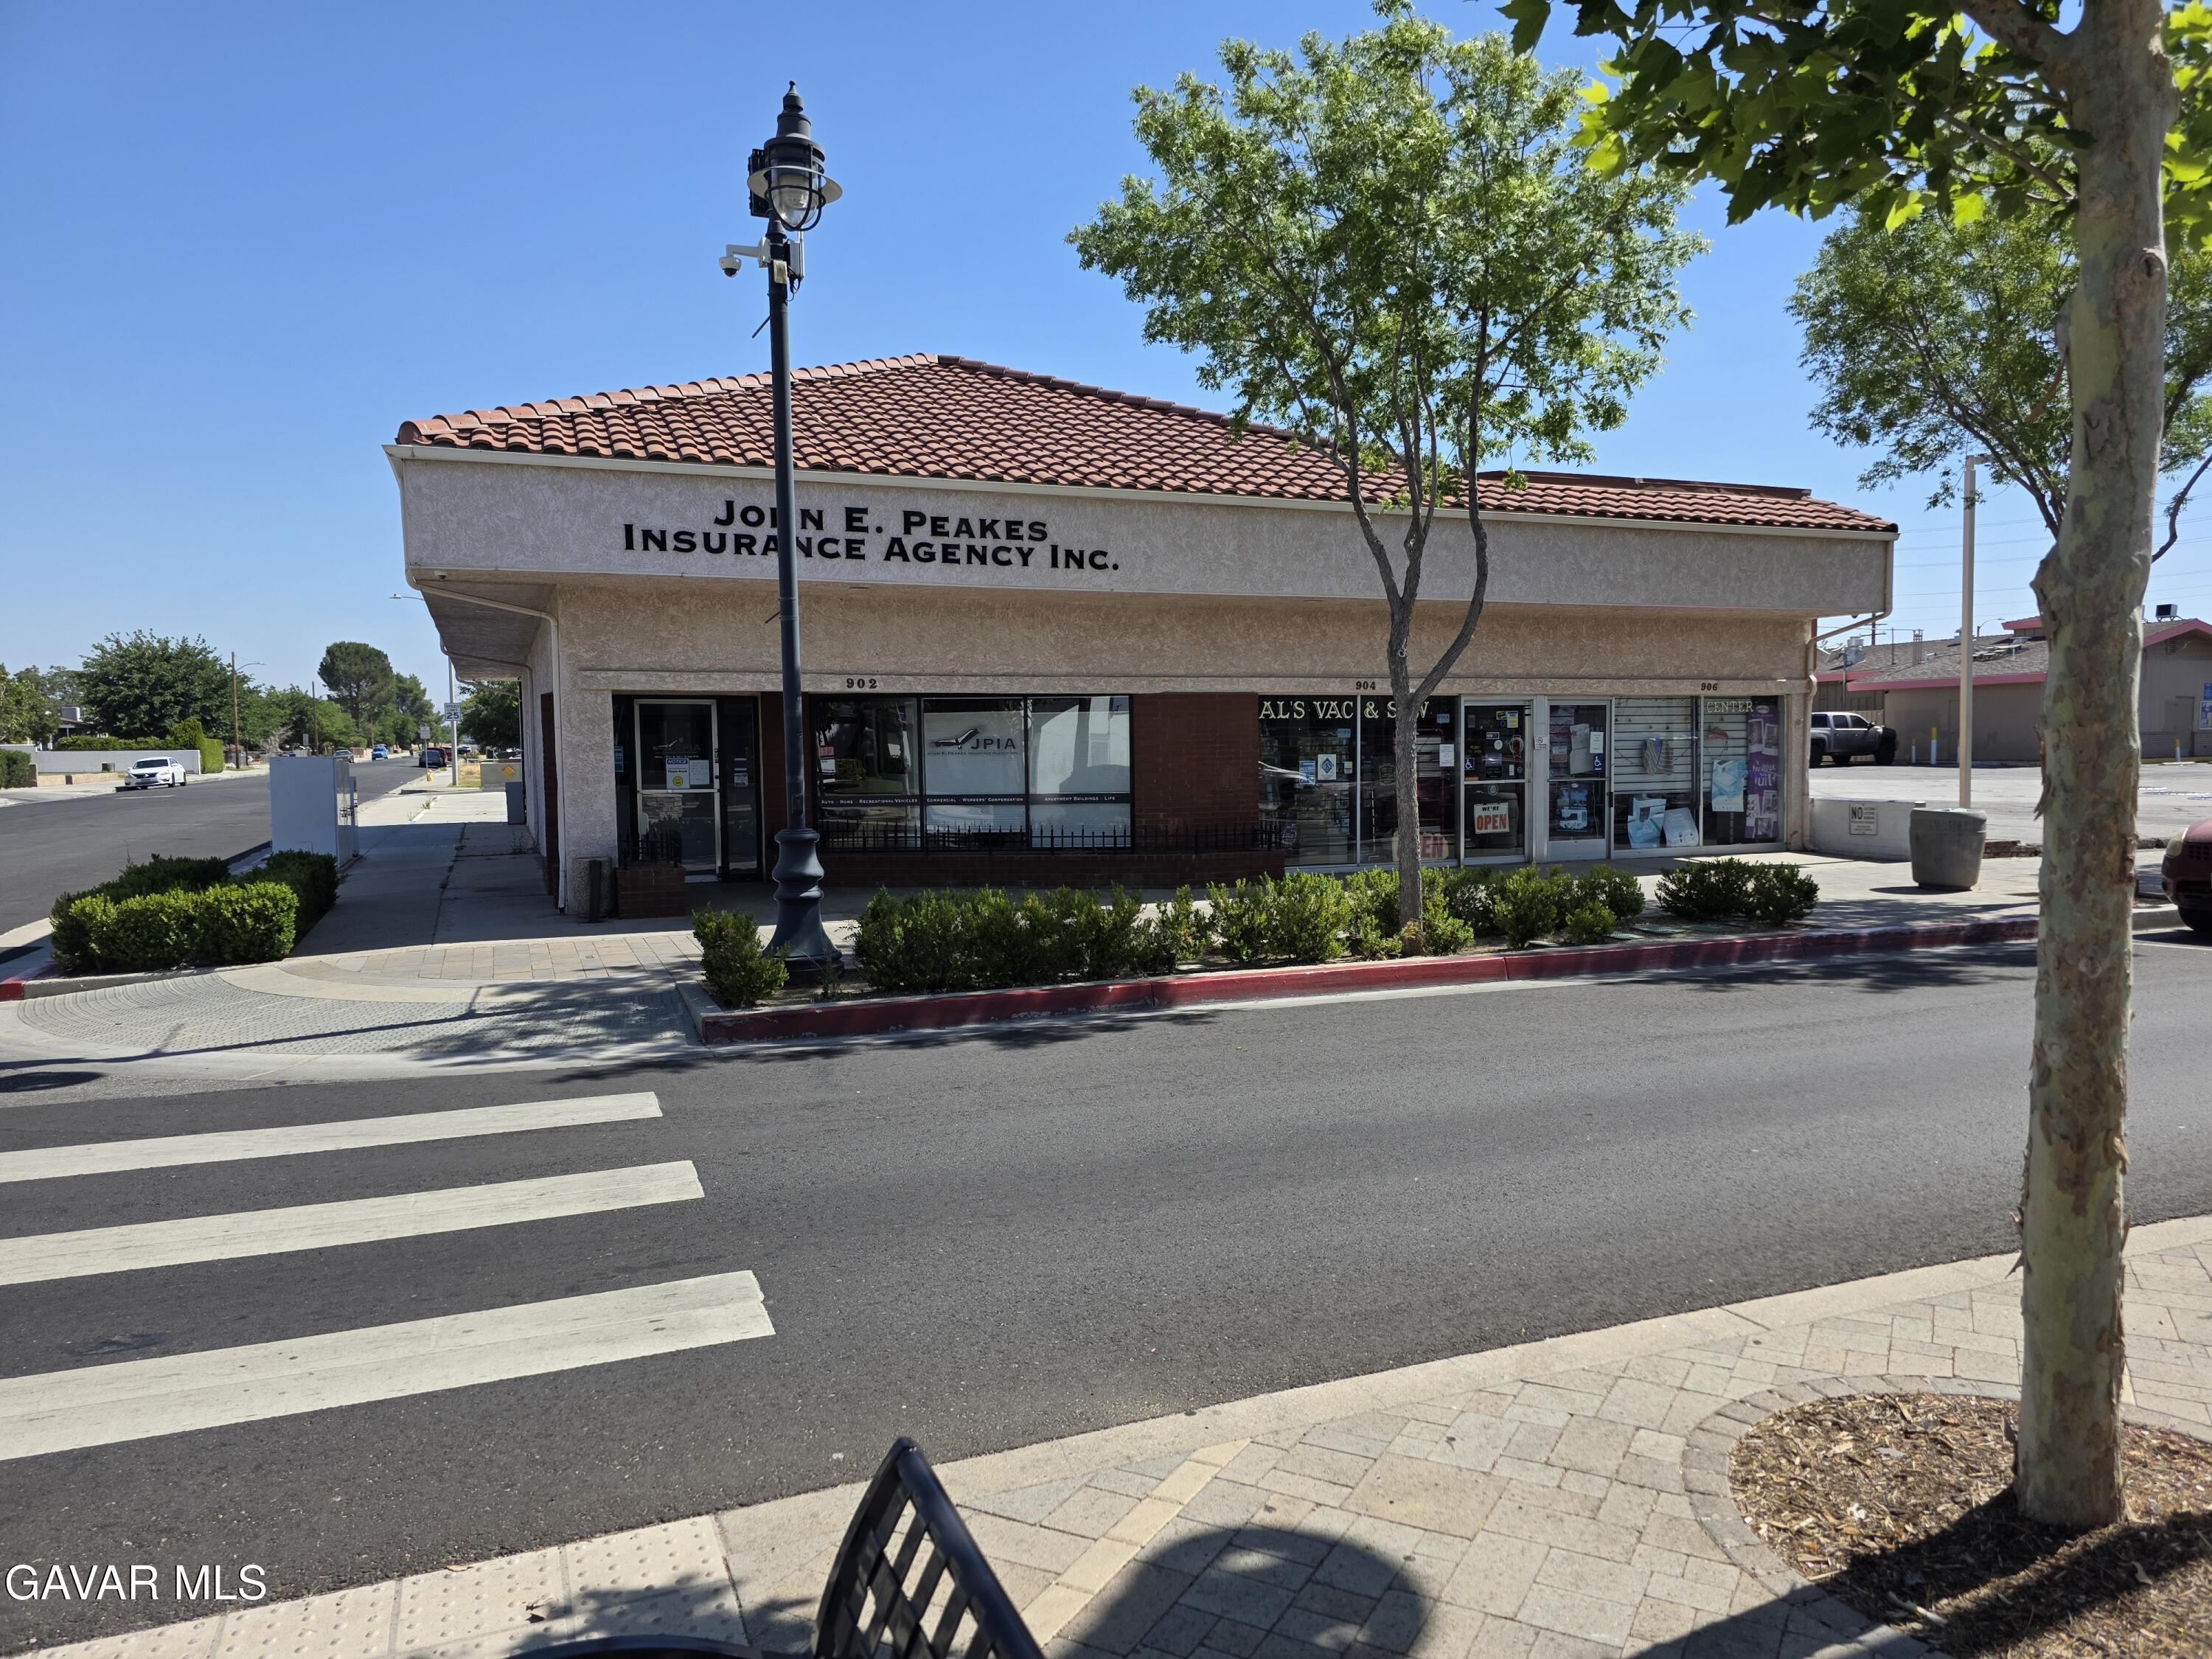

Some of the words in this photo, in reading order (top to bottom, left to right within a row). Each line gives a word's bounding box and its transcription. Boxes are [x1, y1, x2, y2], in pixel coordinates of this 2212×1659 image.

[844, 507, 883, 534] E.
[902, 510, 1048, 542] PEAKES
[624, 524, 866, 560] INSURANCE
[883, 537, 1035, 567] AGENCY
[1051, 544, 1119, 571] INC.
[846, 678, 877, 689] 902
[1356, 681, 1376, 691] 904
[1700, 683, 1718, 691] 906
[1258, 700, 1305, 719] AL'S
[1312, 700, 1354, 719] VAC
[1364, 701, 1379, 719] &
[1387, 700, 1430, 719] SW
[1706, 700, 1754, 713] CENTER
[970, 738, 1016, 750] JPIA
[1851, 807, 1863, 819] NO
[1476, 814, 1506, 831] OPEN
